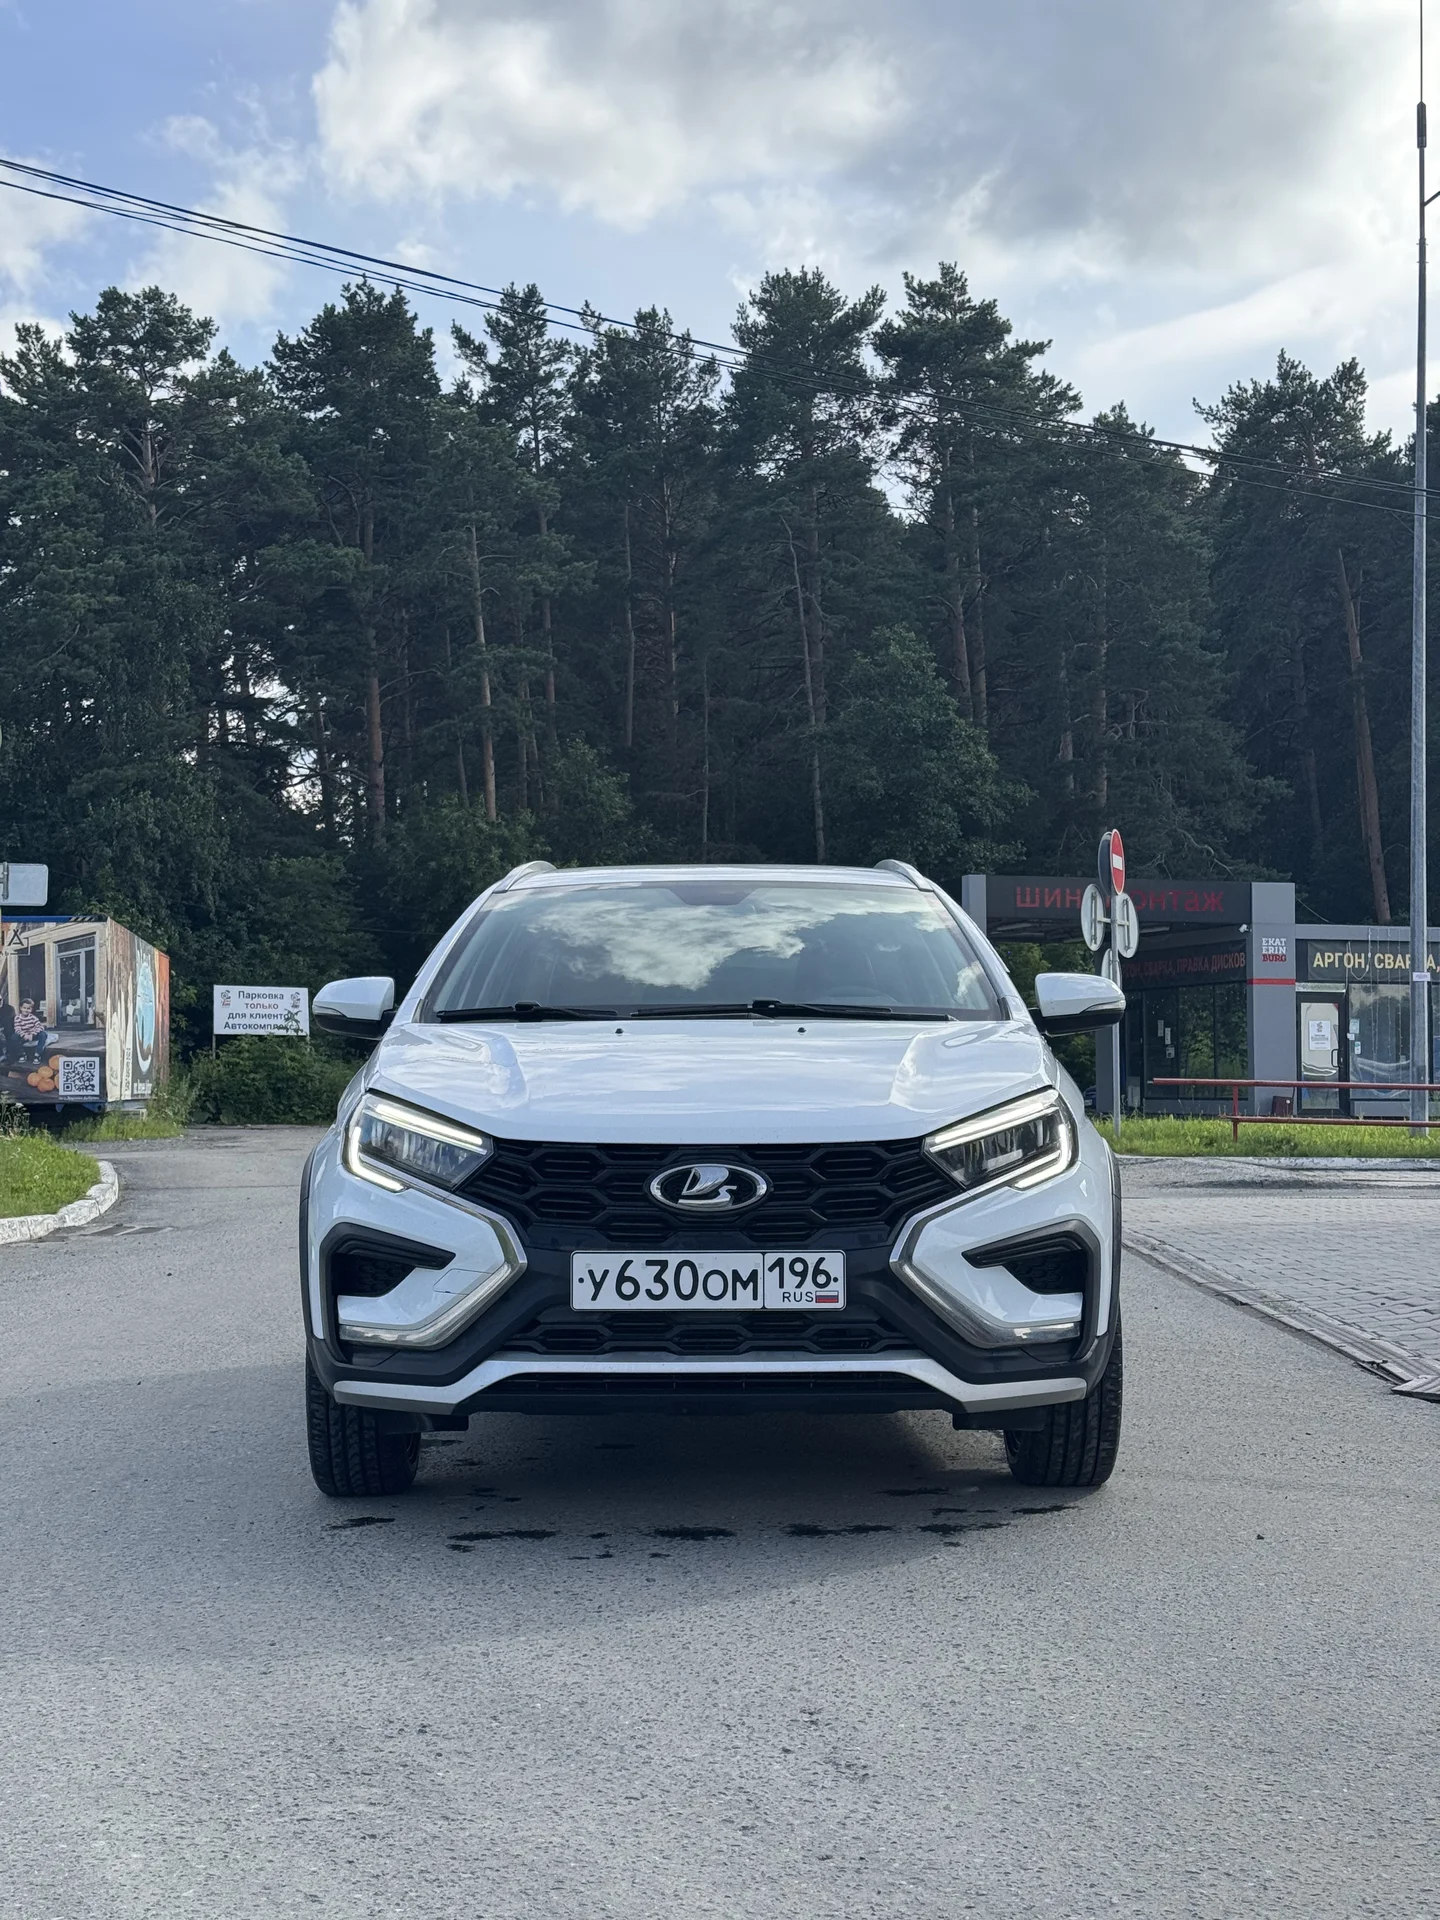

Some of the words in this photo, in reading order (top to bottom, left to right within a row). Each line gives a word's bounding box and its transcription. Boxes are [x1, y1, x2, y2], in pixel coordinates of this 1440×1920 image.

[1262, 938, 1287, 946] EKAT
[1262, 946, 1287, 954] ERIN
[1262, 954, 1287, 962] BURG
[1211, 952, 1246, 973] ДИСКОВ
[238, 990, 284, 1001] Парковка
[245, 1002, 279, 1010] только
[227, 1012, 247, 1020] для
[767, 1257, 832, 1289] 196
[782, 1291, 814, 1303] RUS
